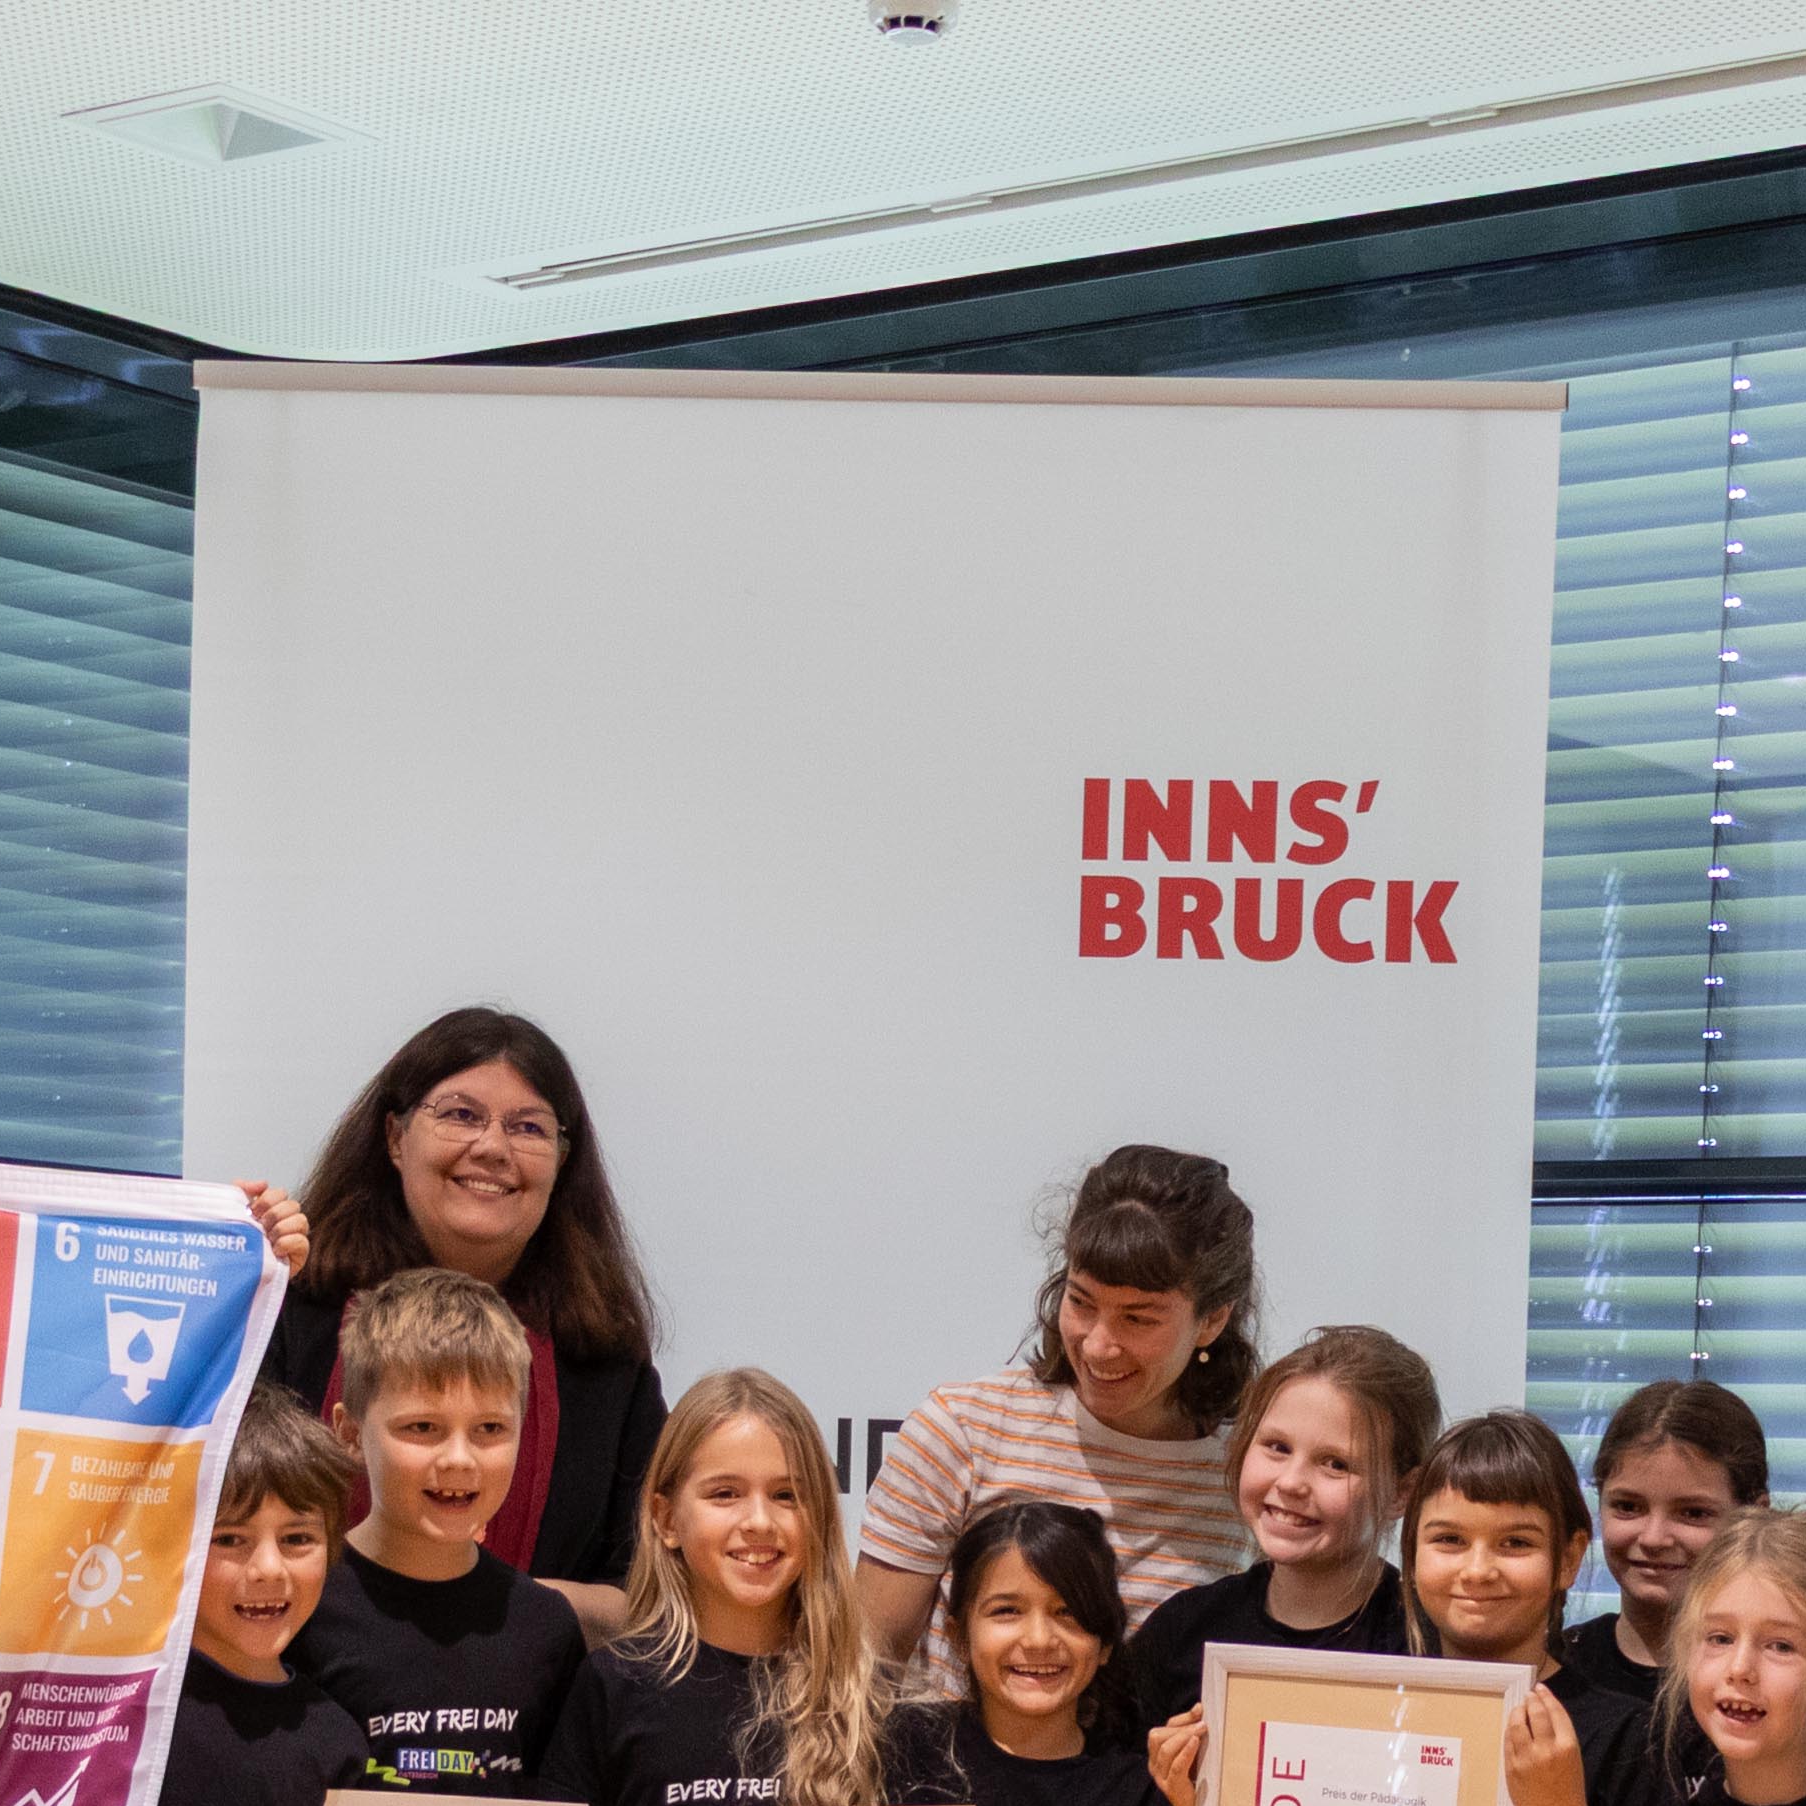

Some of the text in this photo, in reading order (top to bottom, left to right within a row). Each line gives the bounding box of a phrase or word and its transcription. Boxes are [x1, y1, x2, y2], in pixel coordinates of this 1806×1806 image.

[1082, 778, 1380, 865] INNS'
[1079, 875, 1460, 964] BRUCK
[54, 1222, 81, 1262] 6
[183, 1231, 247, 1252] WASSER
[96, 1244, 206, 1270] UND SANITÄR-
[93, 1268, 217, 1297] EINRICHTUNGEN
[33, 1450, 56, 1495] 7
[148, 1462, 175, 1480] UND
[15, 1708, 66, 1727] ARBEIT
[67, 1711, 95, 1728] UND
[369, 1708, 519, 1737] EVERY FREI DAY
[11, 1725, 130, 1752] SCHAFTSWACHSTUM
[1420, 1755, 1454, 1767] BRUCK
[667, 1778, 781, 1804] EVERY FREI
[1322, 1787, 1347, 1800] Preis
[1350, 1791, 1367, 1802] der
